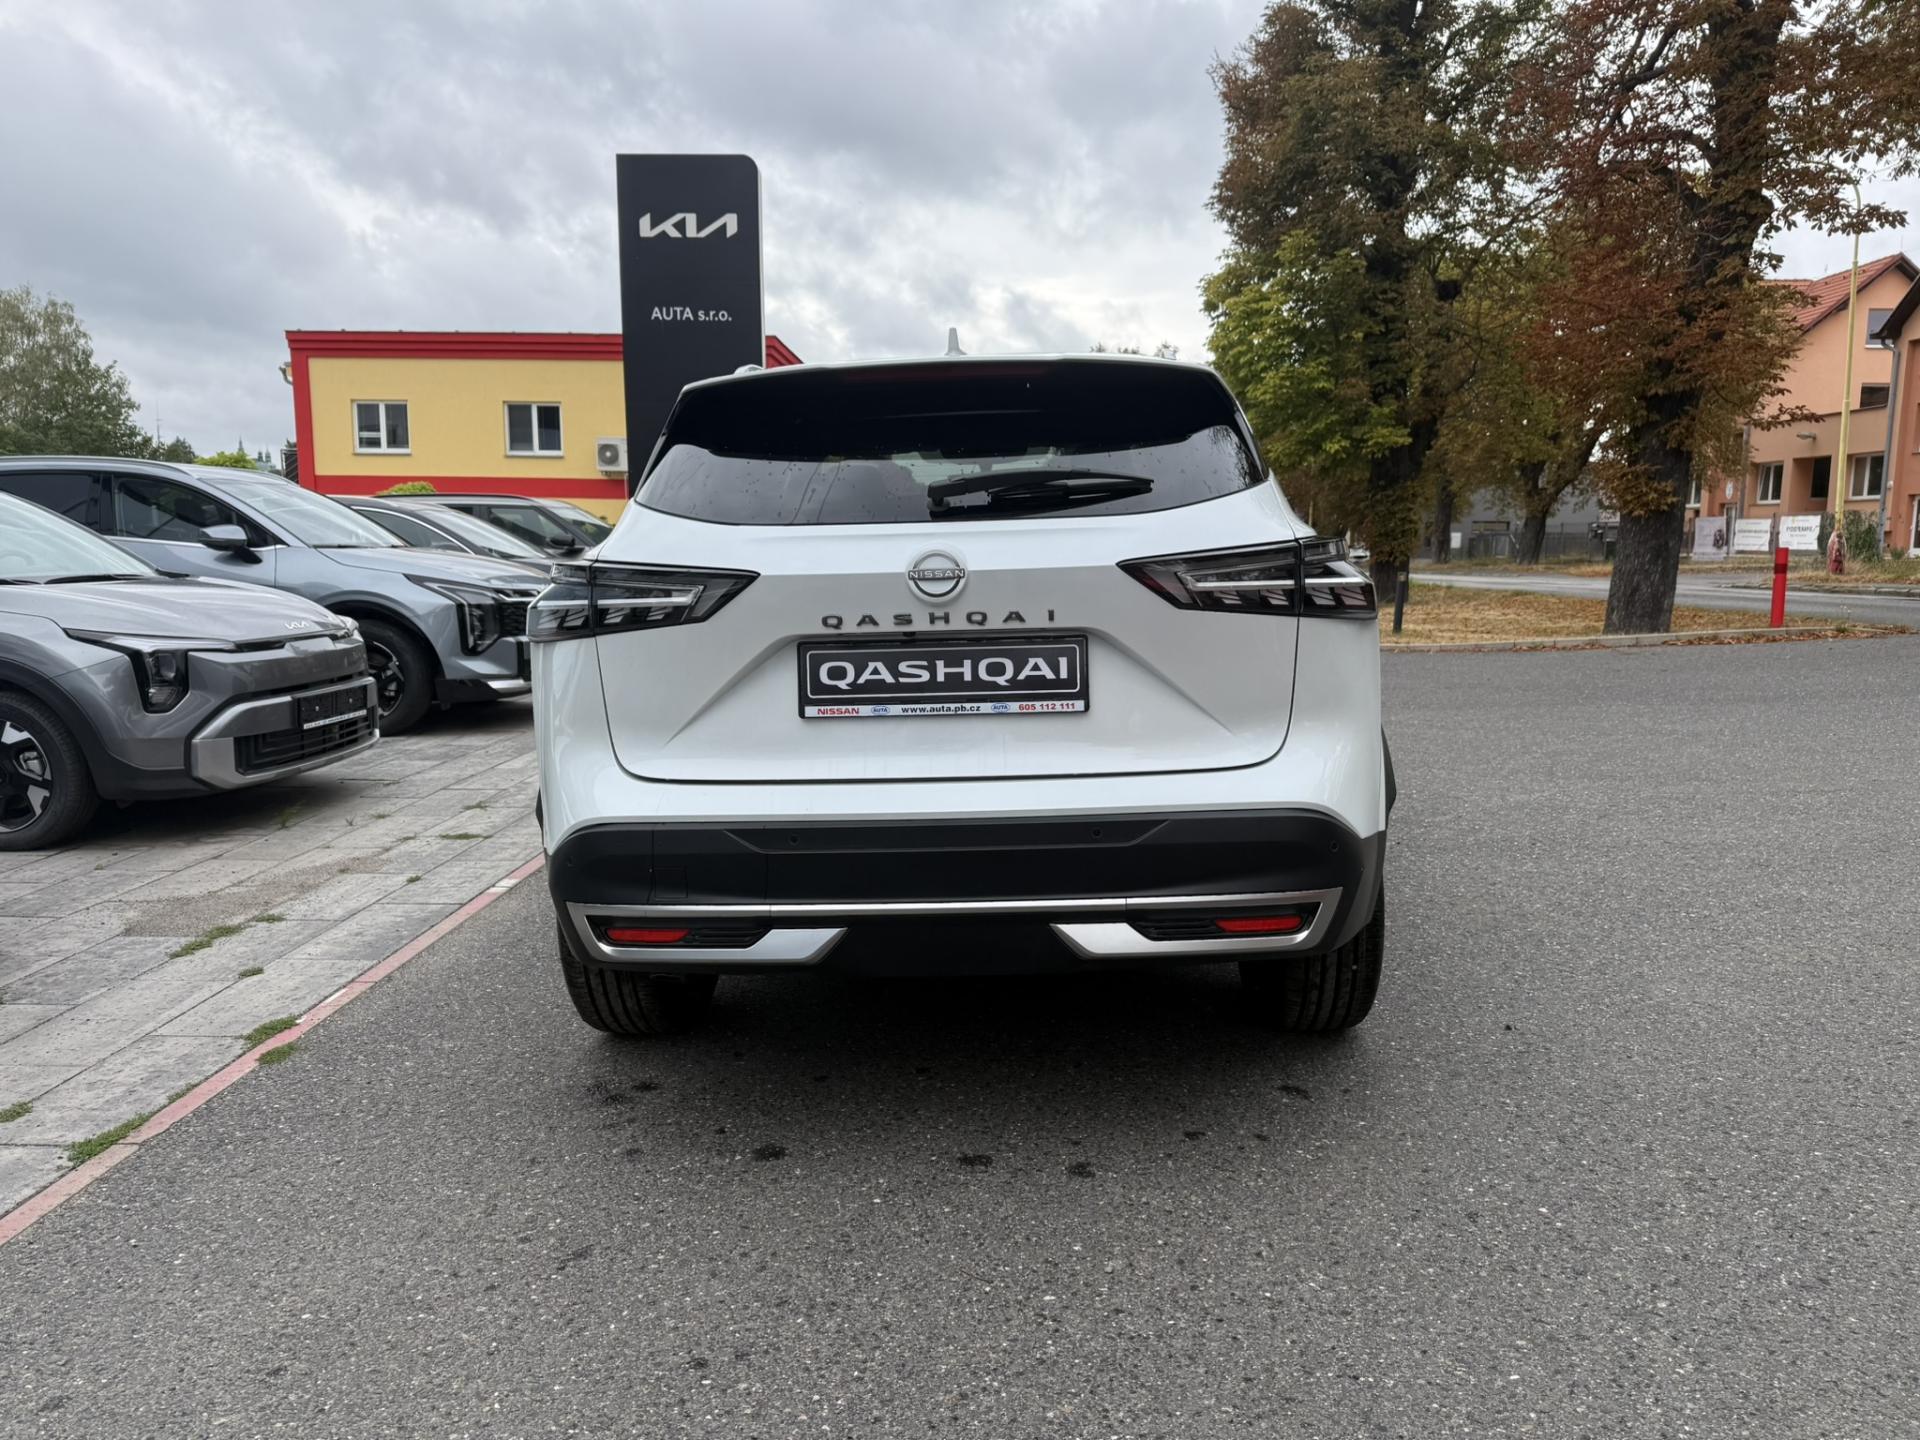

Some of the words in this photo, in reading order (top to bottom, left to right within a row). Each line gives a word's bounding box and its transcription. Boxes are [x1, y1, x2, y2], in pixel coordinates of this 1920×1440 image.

[651, 306, 694, 321] AUTA
[698, 310, 732, 321] s.r.o.
[909, 569, 964, 579] NISSAN
[821, 609, 1055, 630] QASHQAI
[819, 656, 1068, 690] QASHQAI
[817, 707, 860, 715] NISSAN
[901, 704, 981, 714] www.auta.pb.cz
[1018, 703, 1036, 711] 605
[1040, 703, 1057, 711] 112
[1059, 702, 1076, 710] 111
